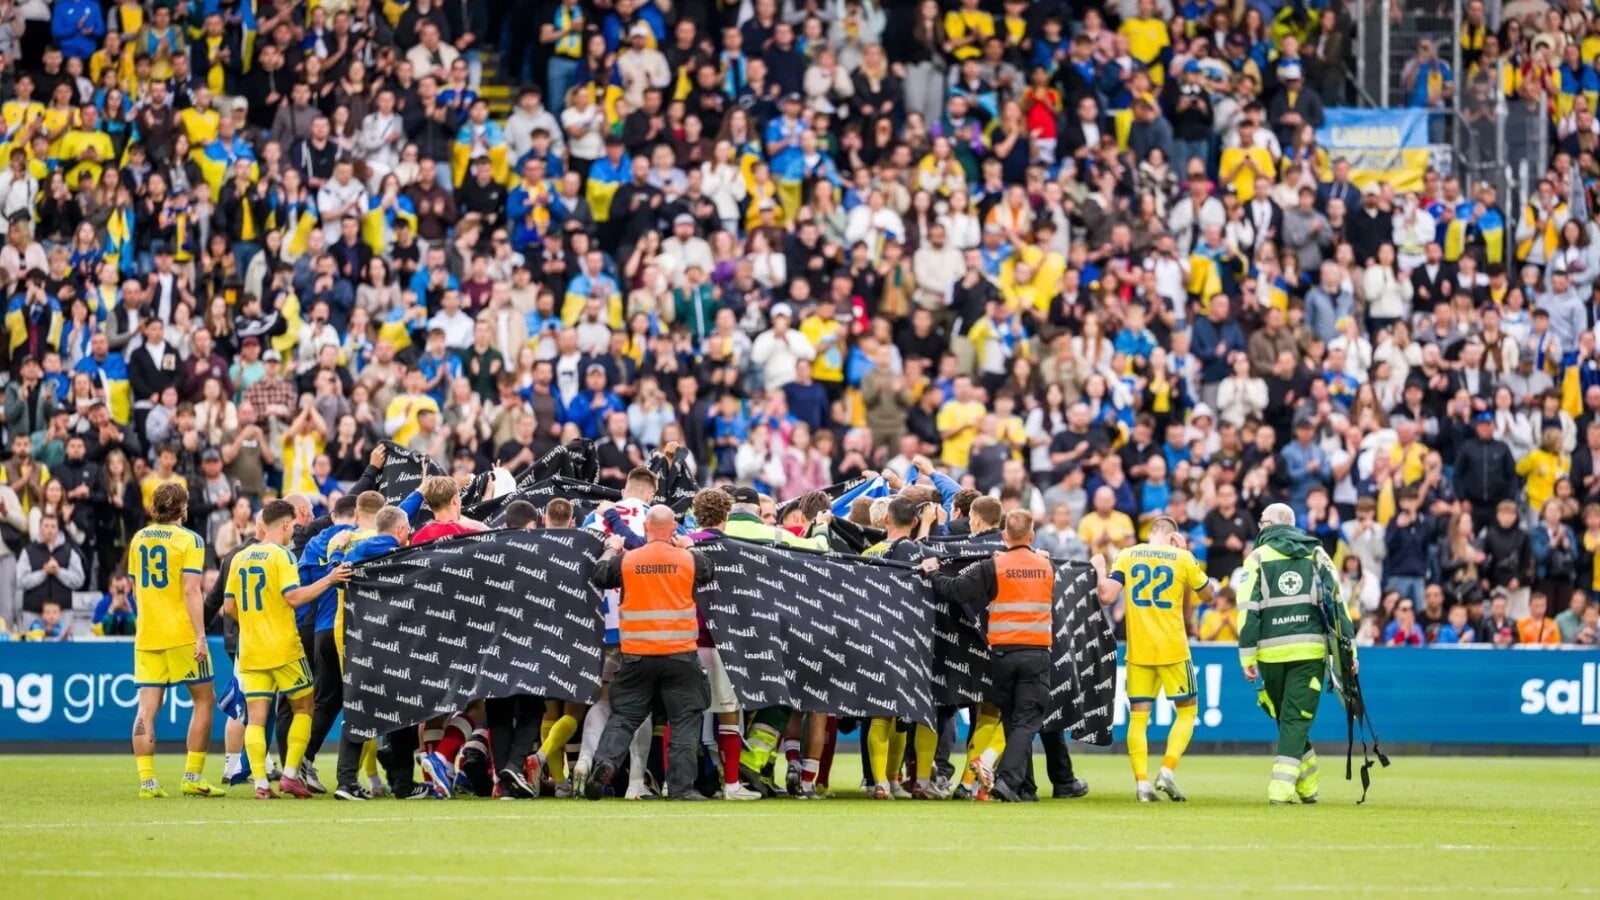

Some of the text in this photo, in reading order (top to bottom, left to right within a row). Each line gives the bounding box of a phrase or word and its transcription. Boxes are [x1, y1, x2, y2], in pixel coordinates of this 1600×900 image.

[844, 477, 866, 491] Alba
[139, 545, 169, 589] 13
[238, 566, 267, 612] 17
[635, 563, 678, 575] SECURITY
[1005, 568, 1047, 579] SECURITY
[1131, 563, 1174, 610] 22
[1272, 614, 1311, 625] SAMARIT
[64, 673, 195, 724] grop
[1520, 662, 1600, 715] sal
